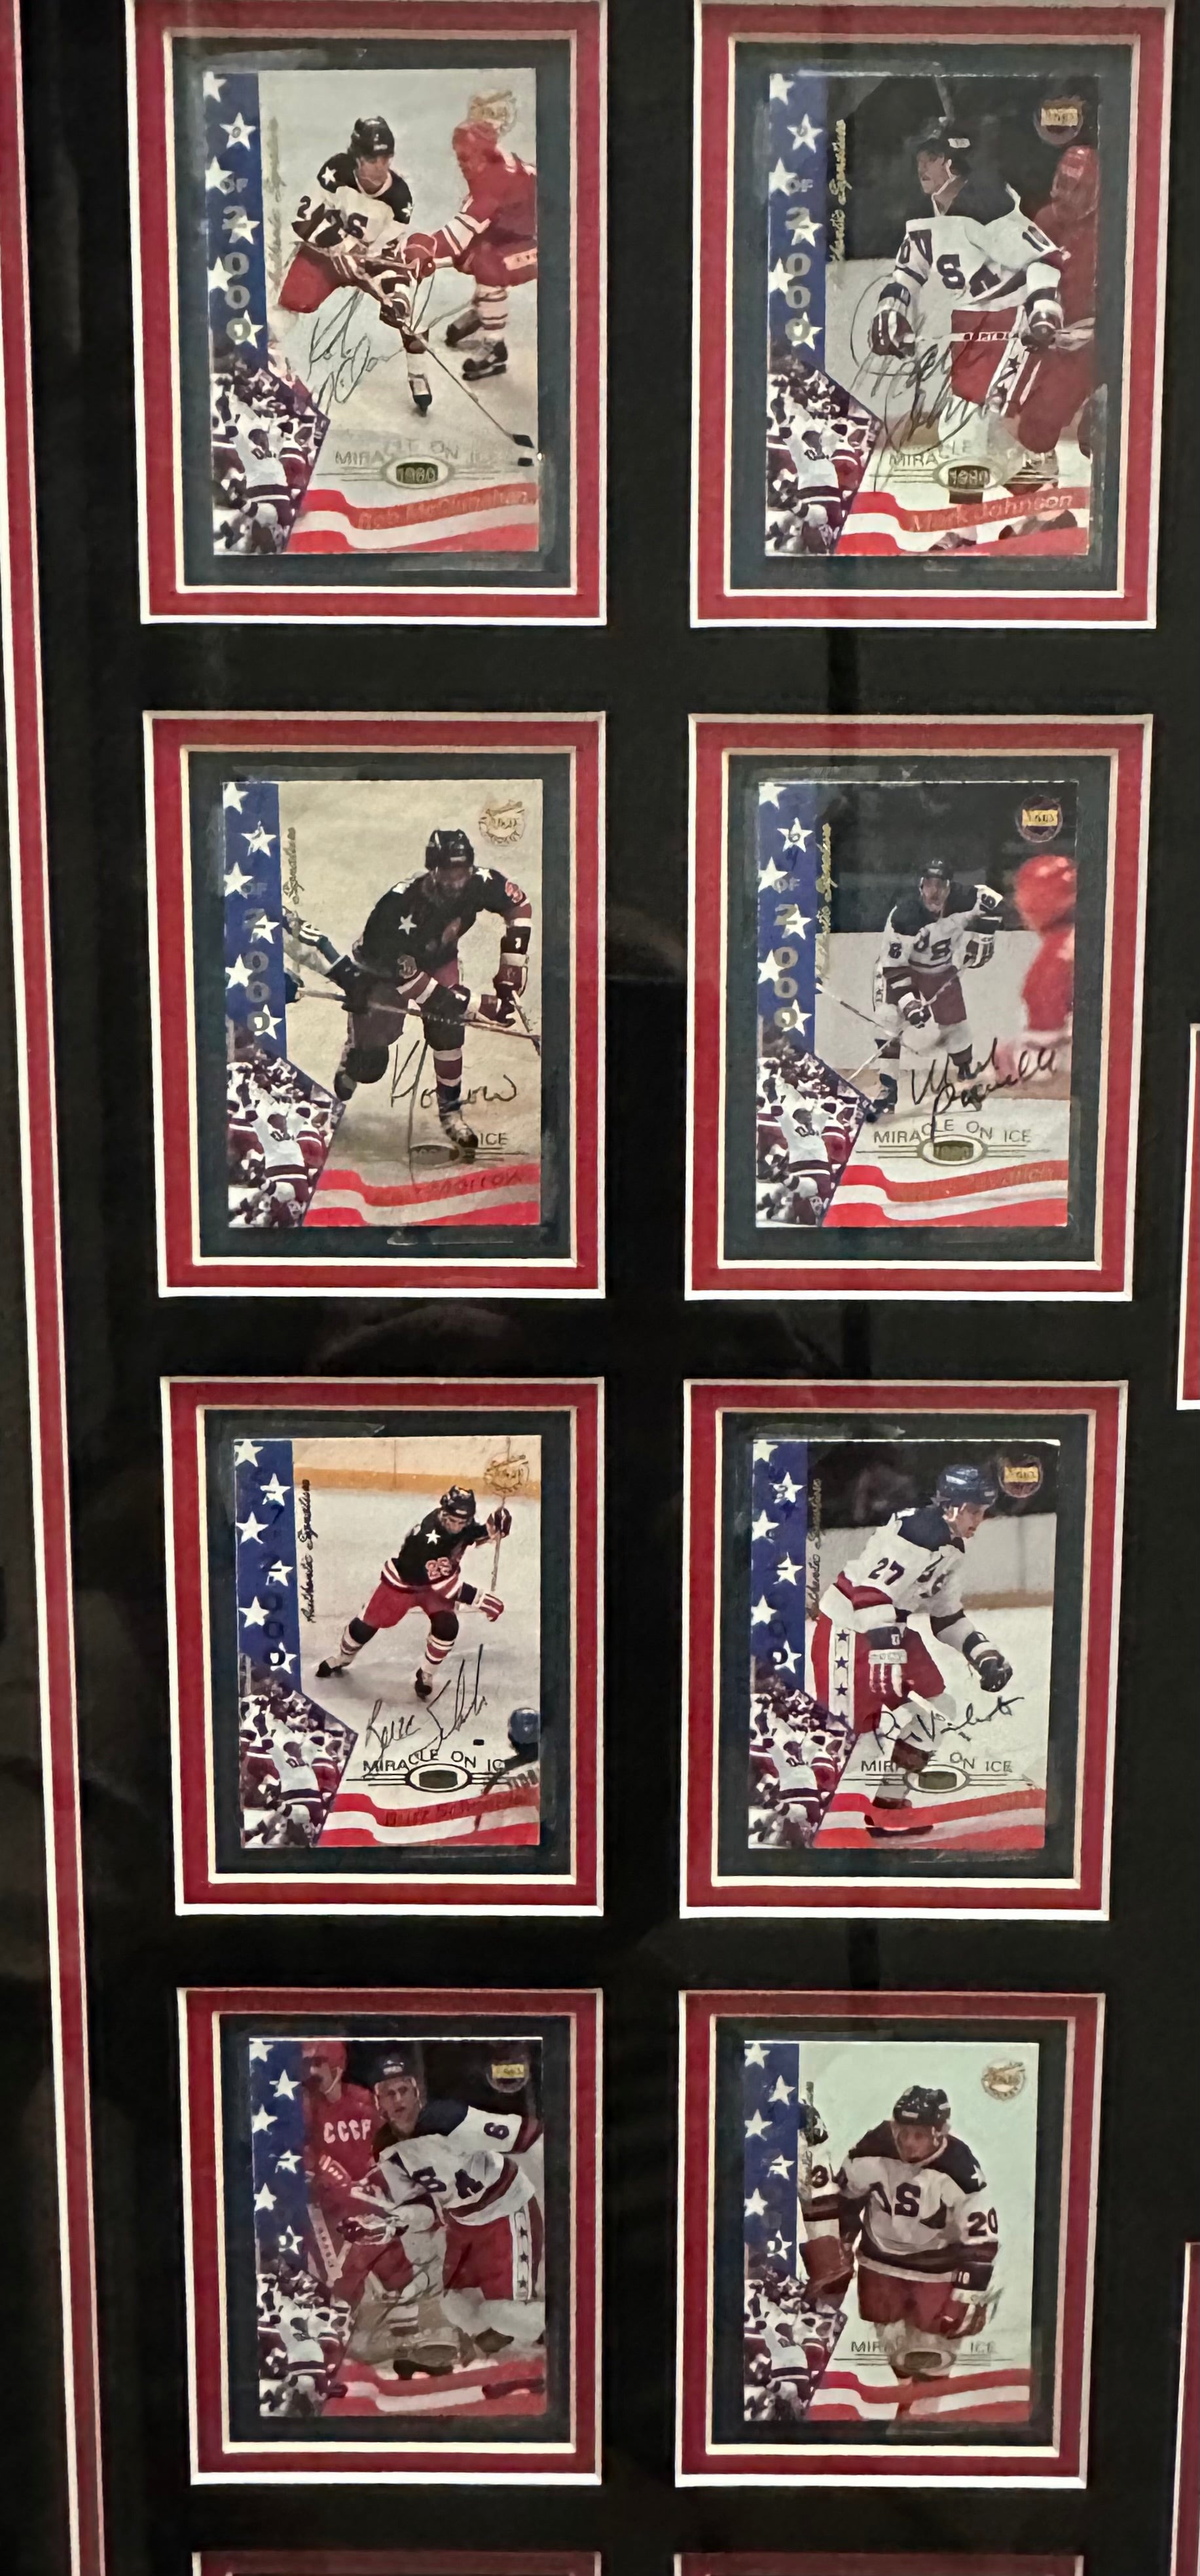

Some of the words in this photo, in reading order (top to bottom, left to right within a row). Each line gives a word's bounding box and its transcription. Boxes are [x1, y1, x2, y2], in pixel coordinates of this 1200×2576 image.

[430, 436, 458, 460] ON
[973, 494, 1074, 521] Johnson
[480, 1132, 508, 1145] ICE
[874, 1118, 954, 1144] MIRACLE
[966, 1120, 993, 1140] ON
[1004, 1130, 1032, 1143] ICE
[868, 1557, 905, 1586] 27
[363, 1750, 439, 1772] MIRACLE
[451, 1750, 477, 1769] ON
[487, 1759, 506, 1772] IC
[949, 1752, 975, 1769] ON
[985, 1761, 1013, 1773] ICE
[968, 2207, 999, 2237] 20
